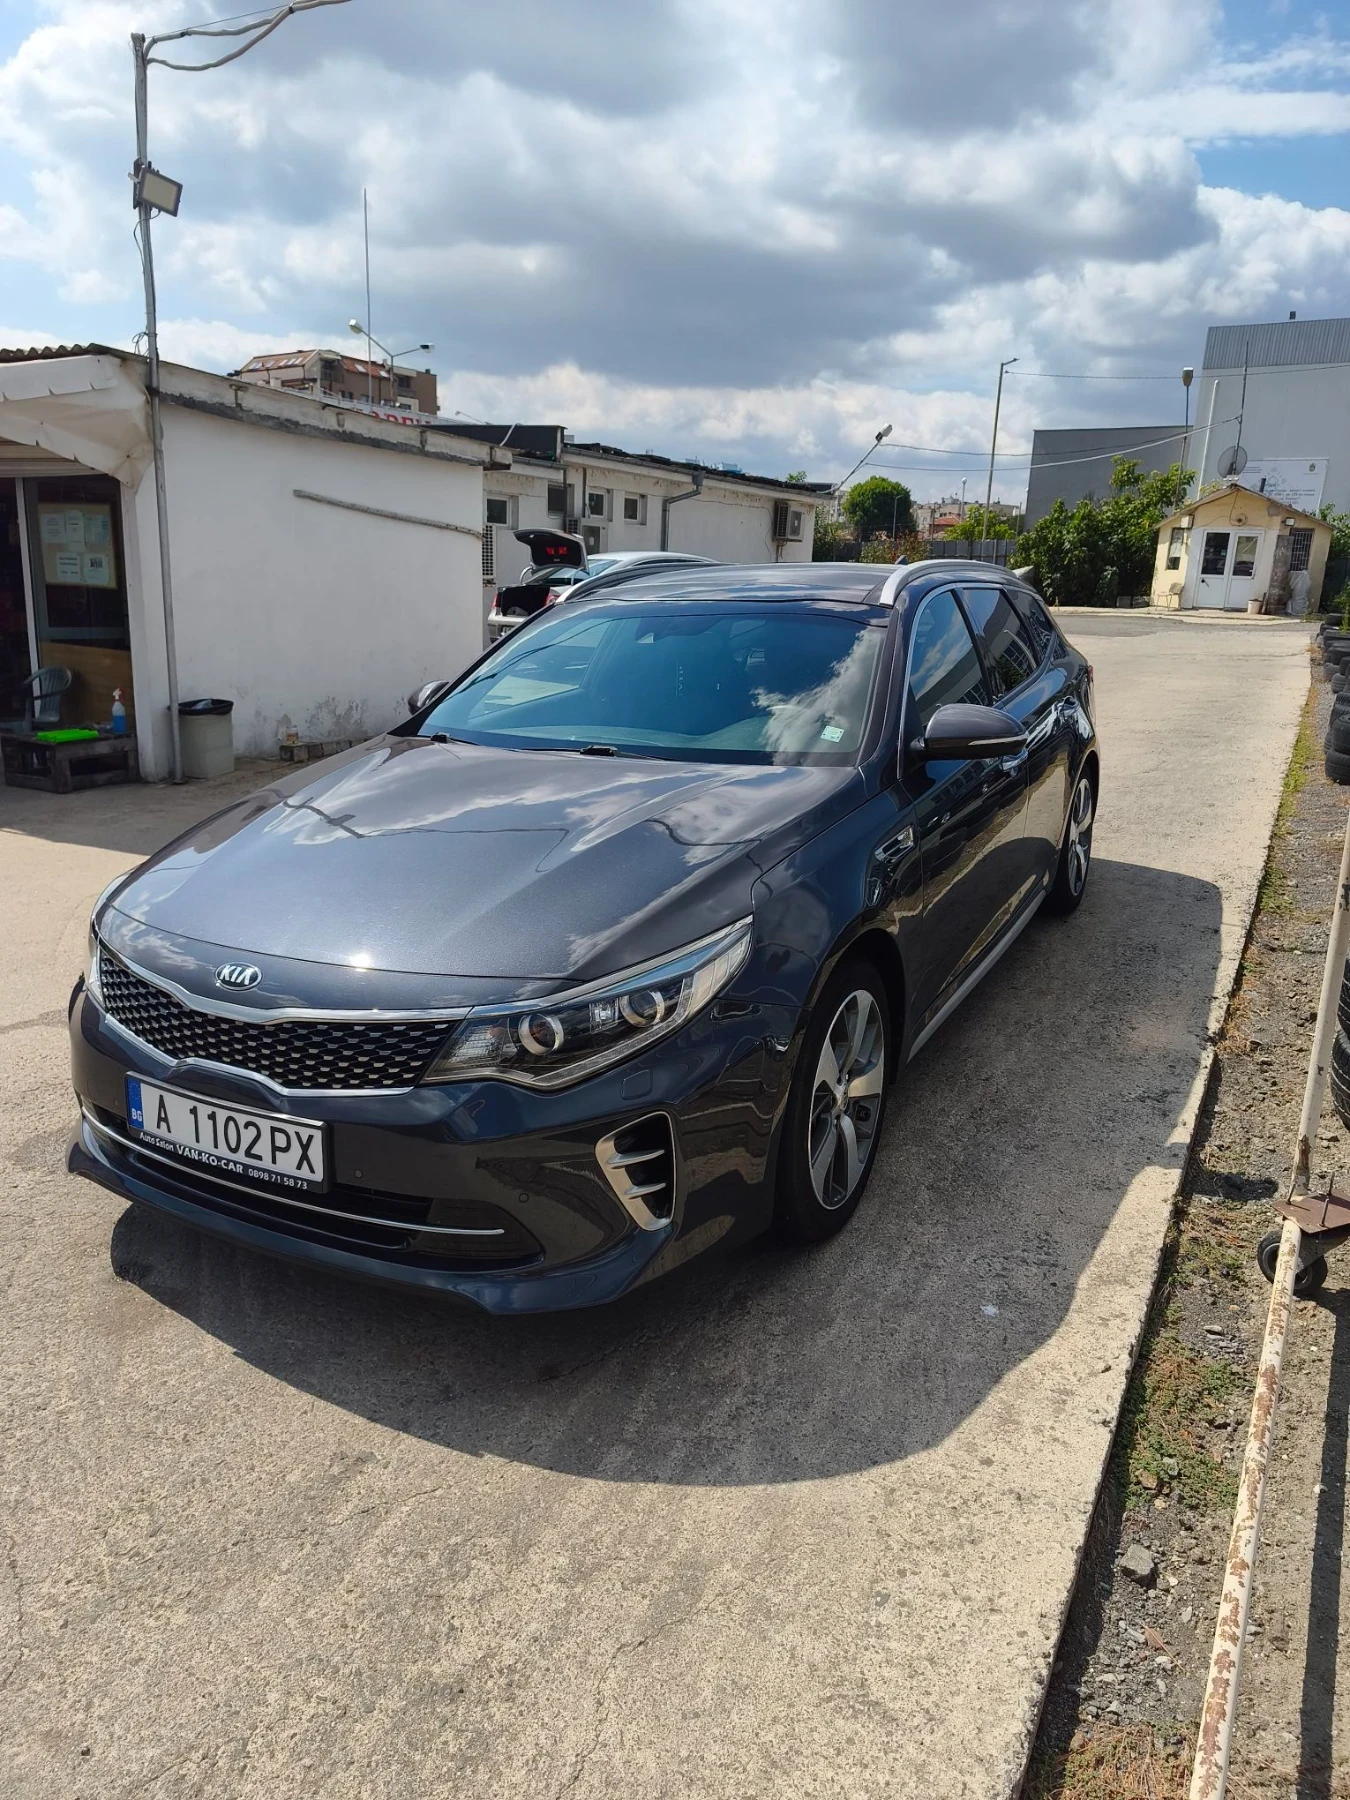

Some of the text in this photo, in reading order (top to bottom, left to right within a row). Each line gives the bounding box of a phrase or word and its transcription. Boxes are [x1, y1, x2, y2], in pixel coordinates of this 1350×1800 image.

[220, 965, 254, 985] KIA
[131, 1108, 143, 1121] BG
[156, 1094, 172, 1134] A
[140, 1132, 308, 1190] Auto Salon VAN-KO-CAR 0898 71 58 73
